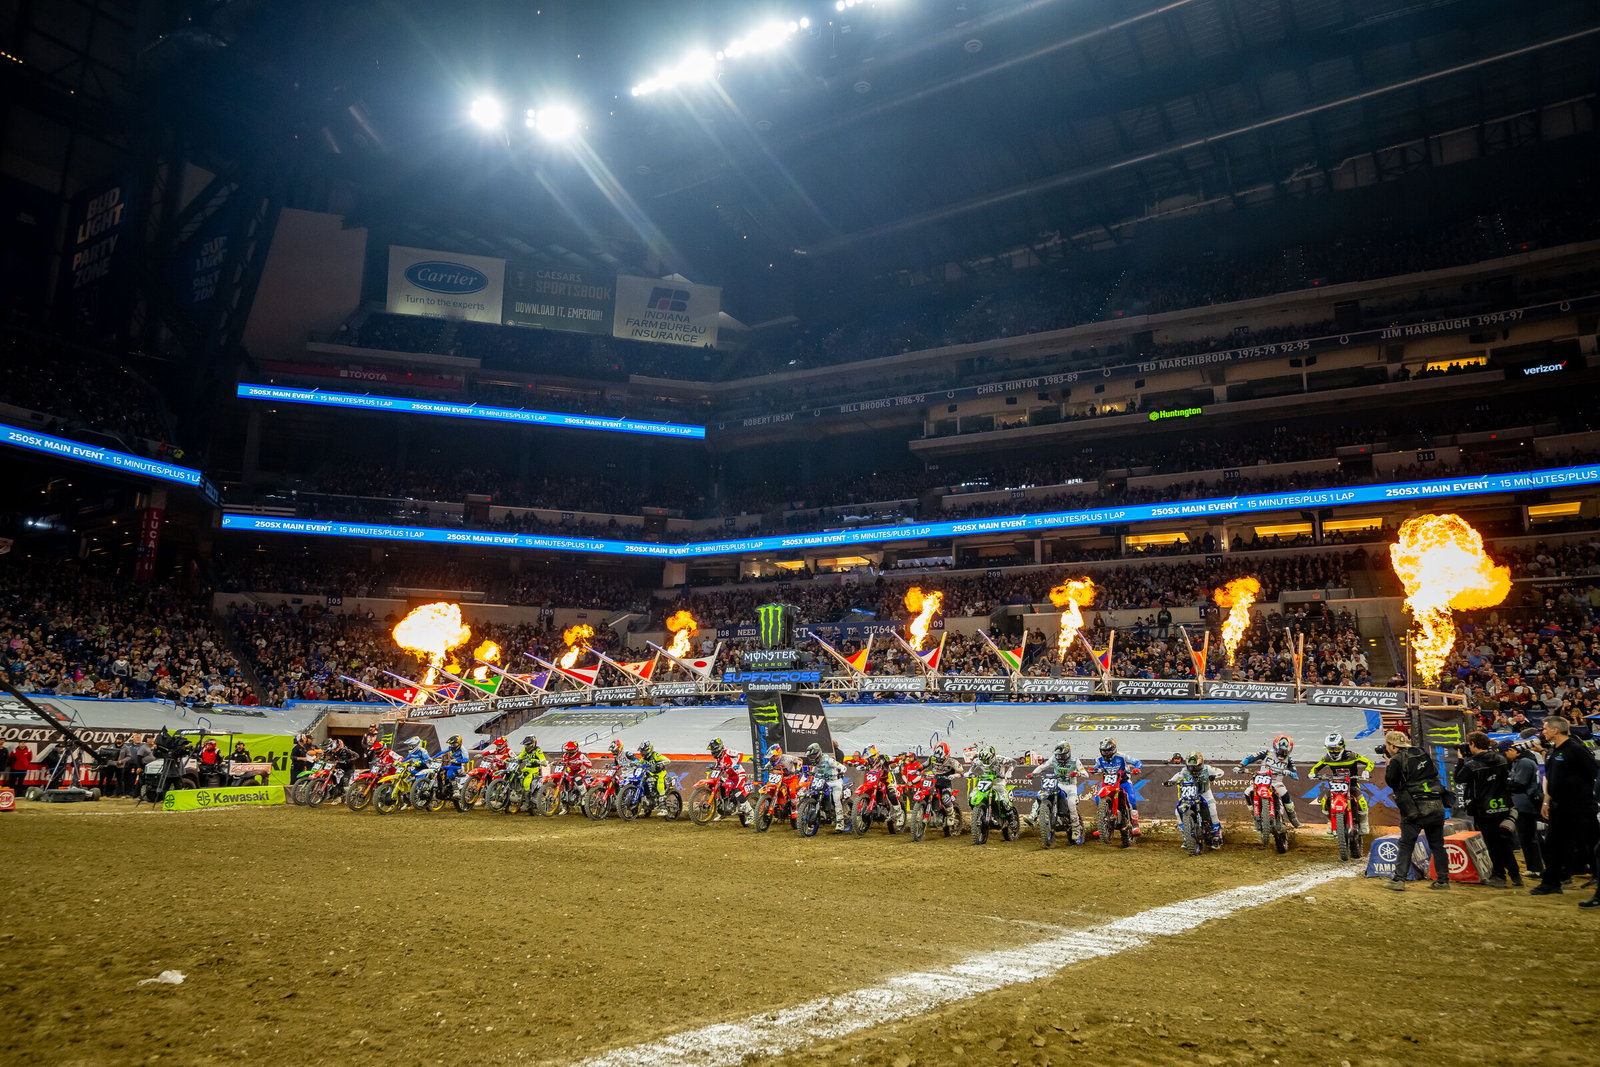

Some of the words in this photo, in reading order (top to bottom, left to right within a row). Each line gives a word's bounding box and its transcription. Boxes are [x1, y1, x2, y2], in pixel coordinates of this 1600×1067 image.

[417, 268, 479, 286] Carrier
[536, 270, 582, 282] CAESARS
[535, 281, 612, 300] SPORTSBOOK
[405, 294, 425, 304] Turn
[427, 297, 436, 306] to
[437, 297, 451, 307] the
[452, 299, 485, 311] experts
[515, 302, 555, 316] DOWNLOAD
[567, 307, 604, 321] EMPEROR!
[644, 311, 691, 323] INDIANA
[1380, 328, 1402, 340] JIM
[1405, 318, 1471, 336] HARBAUGH
[1476, 310, 1525, 326] 1994-97
[631, 328, 699, 343] INSURANCE
[1137, 362, 1156, 373] TED
[1159, 352, 1233, 370] MARCHIBRODA
[1237, 346, 1276, 359] 1975-79
[1280, 341, 1310, 352] 92-95
[349, 370, 388, 381] TOYOTA
[1522, 362, 1563, 376] verizon
[976, 385, 1004, 396] CHRIS
[1005, 379, 1039, 391] HINTON
[1043, 373, 1079, 386] 1983-89
[248, 388, 272, 398] 250SX
[272, 390, 291, 398] MAIN
[292, 391, 315, 400] EVENT
[328, 395, 375, 406] MINUTES/PLUS
[411, 403, 433, 411] 250SX
[452, 406, 473, 414] EVENT
[486, 410, 530, 420] MINUTES/PLUS
[840, 403, 858, 414] BILL
[860, 400, 891, 411] BROOKS
[1160, 407, 1202, 418] Huntington
[564, 417, 584, 425] 250SX
[584, 418, 601, 426] MAIN
[602, 420, 622, 428] EVENT
[634, 424, 675, 433] MINUTES/PLUS
[743, 417, 772, 427] ROBERT
[772, 413, 794, 423] IRSAY
[8, 432, 42, 447] 250SX
[44, 440, 71, 453] MAIN
[73, 447, 105, 460] EVENT
[113, 457, 122, 465] 15
[123, 459, 185, 480] MINUTES/PLUS
[1418, 452, 1435, 461] 311
[1385, 487, 1420, 497] 250SX
[1422, 484, 1451, 494] MAIN
[1453, 481, 1490, 491] EVENT
[1499, 479, 1511, 487] 15
[1514, 470, 1598, 486] MINUTES/PLUS
[1151, 507, 1180, 516] 250SX
[1181, 504, 1206, 514] MAIN
[1207, 502, 1238, 511] EVENT
[1247, 500, 1257, 508] 15
[1258, 495, 1328, 507] MINUTES/PLUS
[1336, 492, 1355, 501] LAP
[255, 520, 282, 529] 250SX
[282, 522, 304, 530] MAIN
[305, 523, 332, 532] EVENT
[348, 527, 404, 537] MINUTES/PLUS
[952, 523, 977, 532] 250SX
[978, 521, 999, 530] MAIN
[1000, 519, 1027, 528] EVENT
[1043, 513, 1102, 525] MINUTES/PLUS
[1109, 511, 1125, 519] LAP
[447, 533, 471, 541] 250SX
[493, 536, 519, 544] EVENT
[533, 539, 585, 549] MINUTES/PLUS
[781, 537, 803, 546] 250SX
[804, 536, 823, 544] MAIN
[823, 534, 846, 543] EVENT
[860, 530, 911, 540] MINUTES/PLUS
[916, 527, 931, 535] LAP
[625, 545, 648, 553] 250SX
[648, 546, 668, 554] MAIN
[702, 543, 746, 553] MINUTES/PLUS
[717, 629, 730, 637] 108
[737, 628, 757, 636] NEED
[744, 650, 797, 662] MONSTER
[723, 671, 822, 684] SUPERCROSS
[1033, 678, 1054, 686] ROCKY
[1127, 680, 1151, 688] ROCKY
[1151, 681, 1190, 689] MOUNTAIN
[748, 683, 792, 692] Championship
[1221, 683, 1245, 691] ROCKY
[1246, 684, 1288, 692] MOUNTAIN
[1326, 688, 1353, 696] ROCKY
[1353, 689, 1399, 698] MOUNTAIN
[783, 712, 825, 730] FLY
[1068, 723, 1141, 731] HARDER
[1163, 723, 1242, 731] HARDER
[866, 773, 877, 783] 96
[1254, 775, 1271, 785] 66
[977, 780, 992, 792] 57
[1330, 783, 1348, 793] 330
[213, 790, 269, 804] Kawasaki
[1489, 798, 1506, 809] 61
